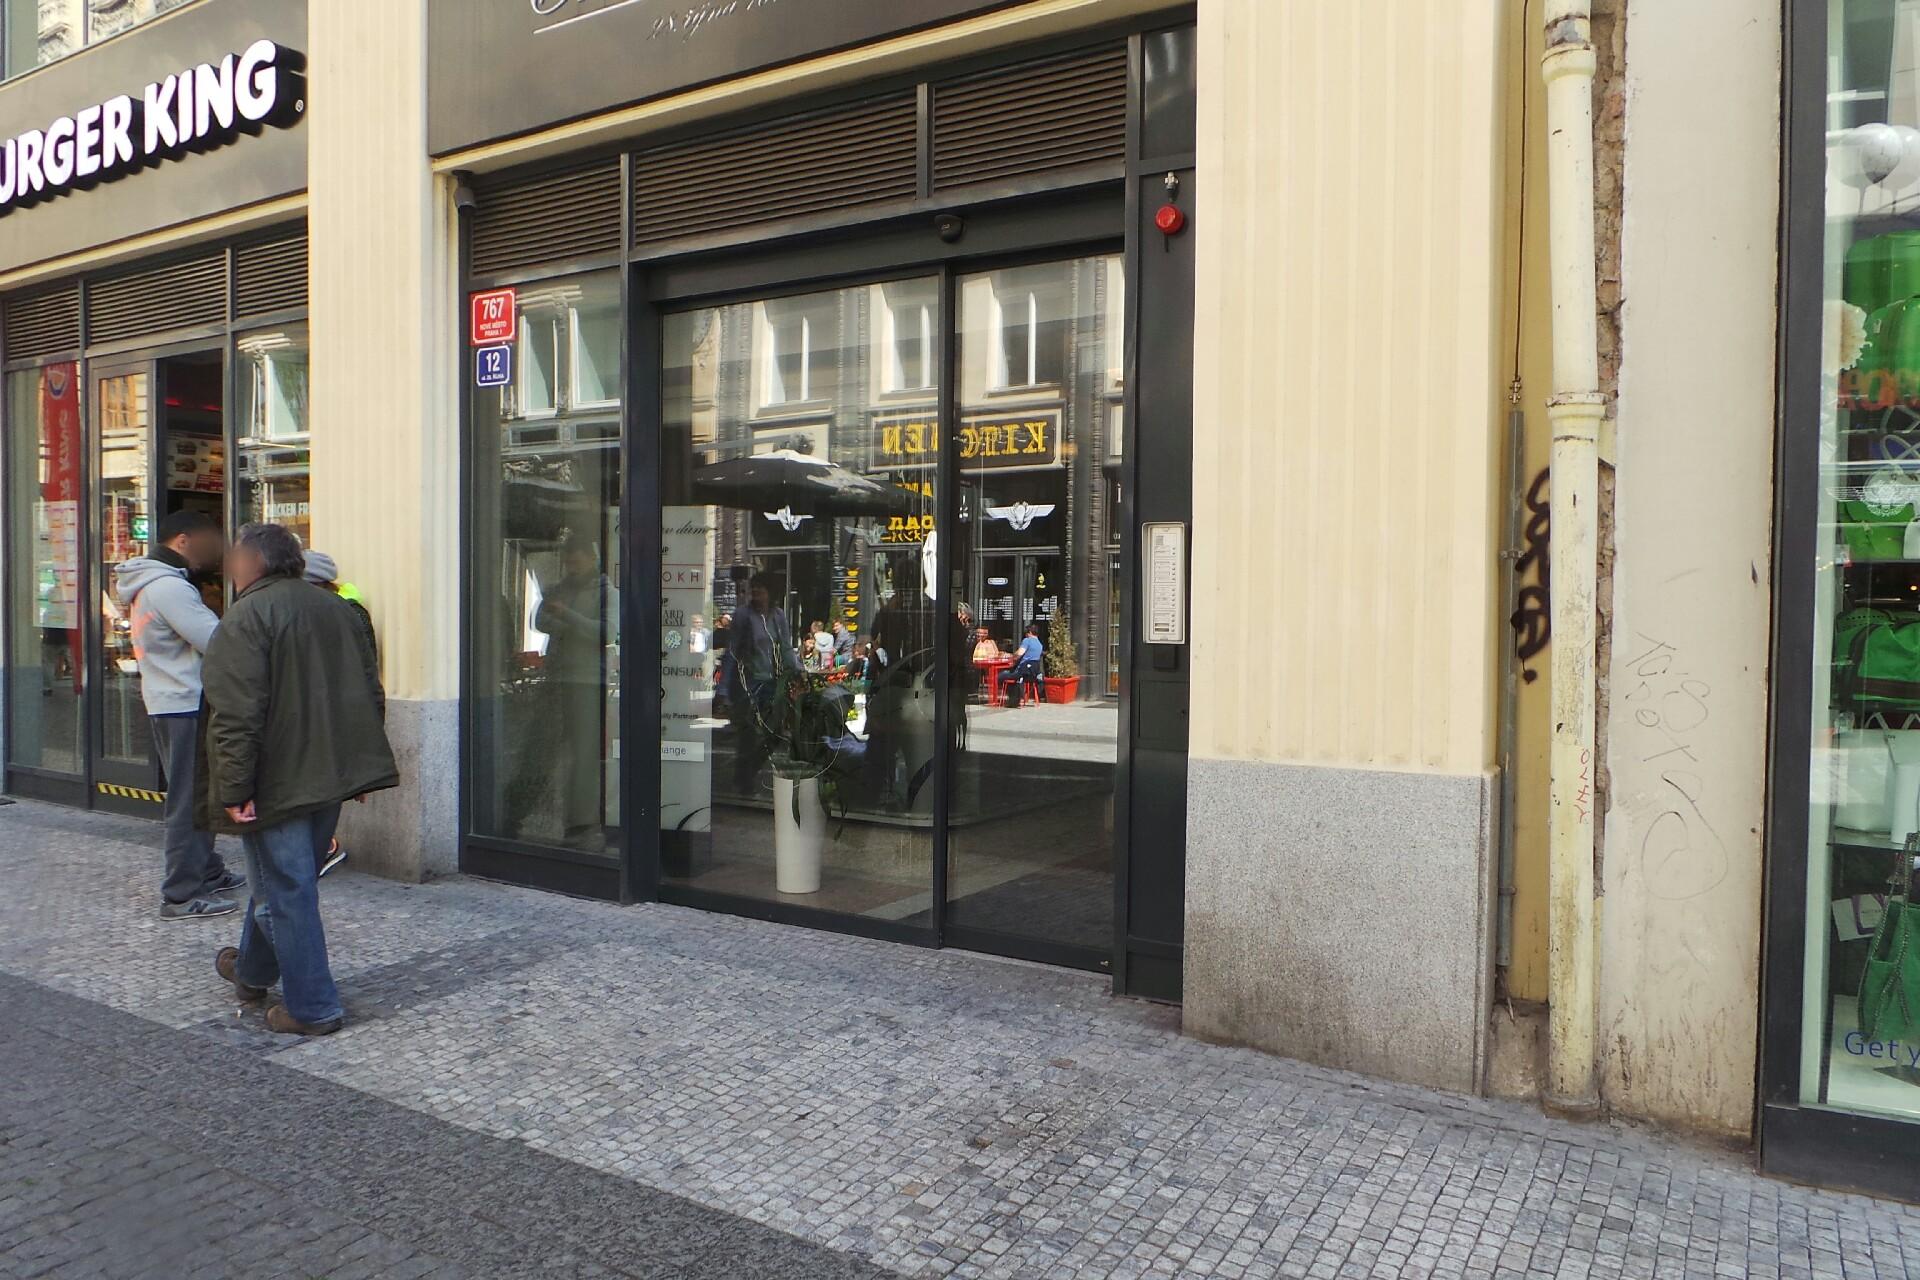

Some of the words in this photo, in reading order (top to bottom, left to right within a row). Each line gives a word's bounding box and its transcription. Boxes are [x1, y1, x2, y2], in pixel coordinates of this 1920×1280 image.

[144, 39, 277, 155] KING
[482, 297, 504, 320] 767
[486, 351, 500, 373] 12
[1845, 1031, 1899, 1060] Get
